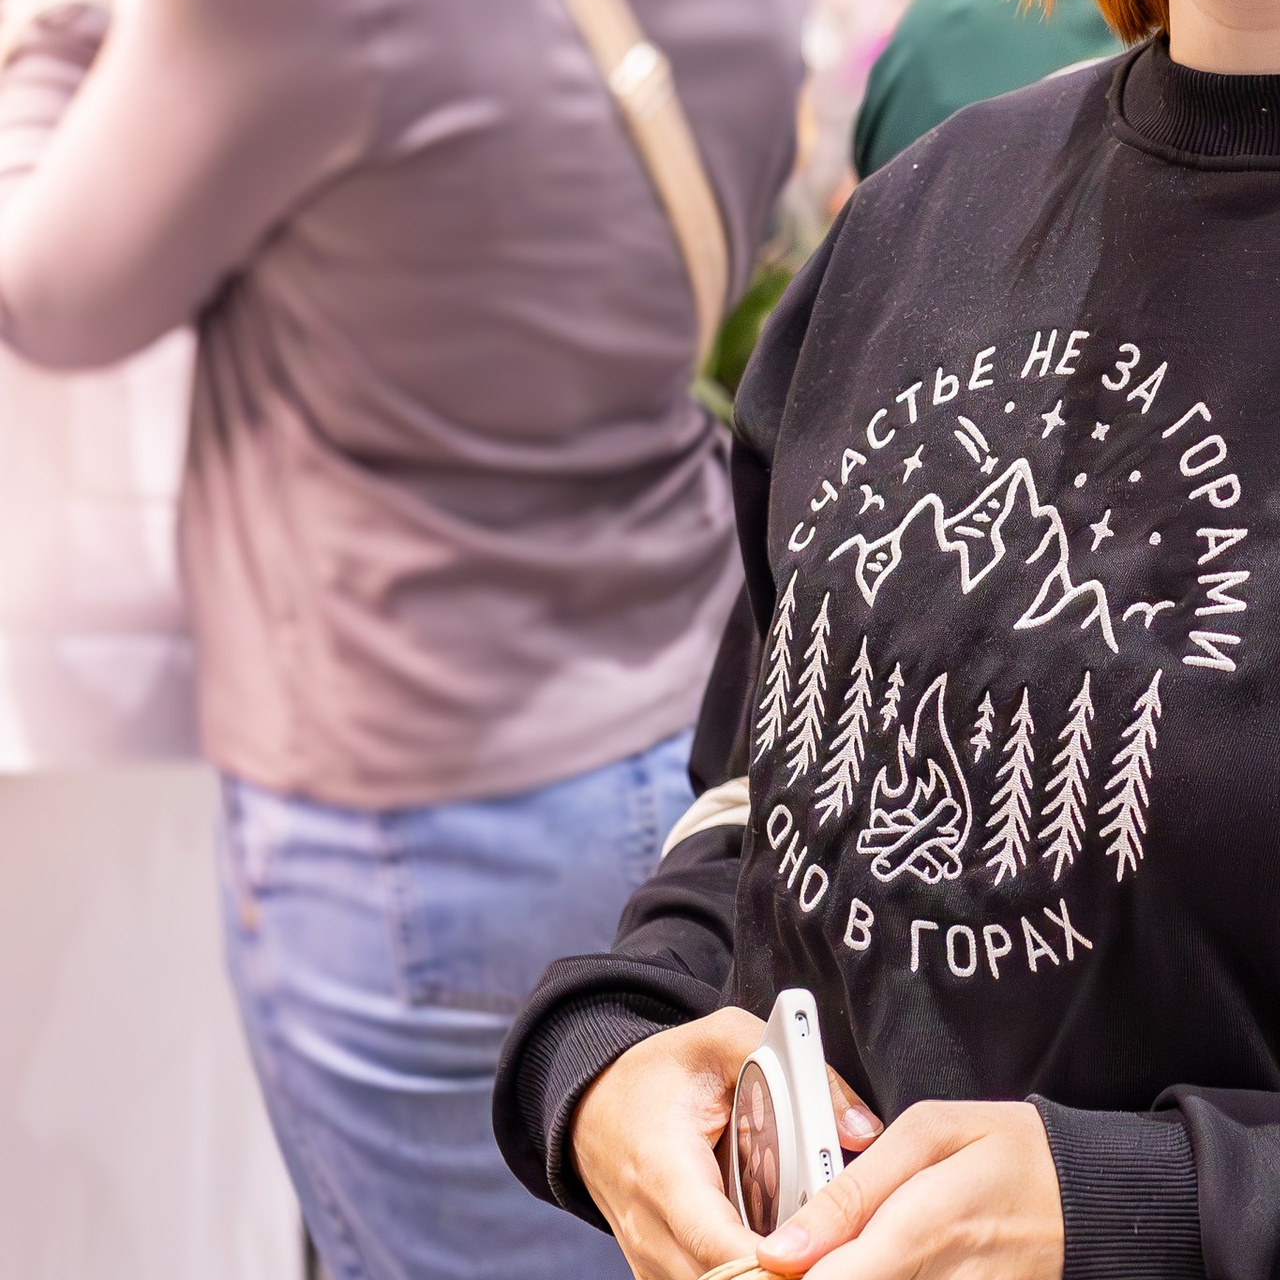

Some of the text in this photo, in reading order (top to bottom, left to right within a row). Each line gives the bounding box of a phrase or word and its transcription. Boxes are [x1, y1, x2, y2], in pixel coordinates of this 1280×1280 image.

[787, 328, 1251, 673] СЧАСТЬЕ НЕ ЗА ГОРАМИ
[766, 803, 1095, 980] ОНО В ГОРАХ
